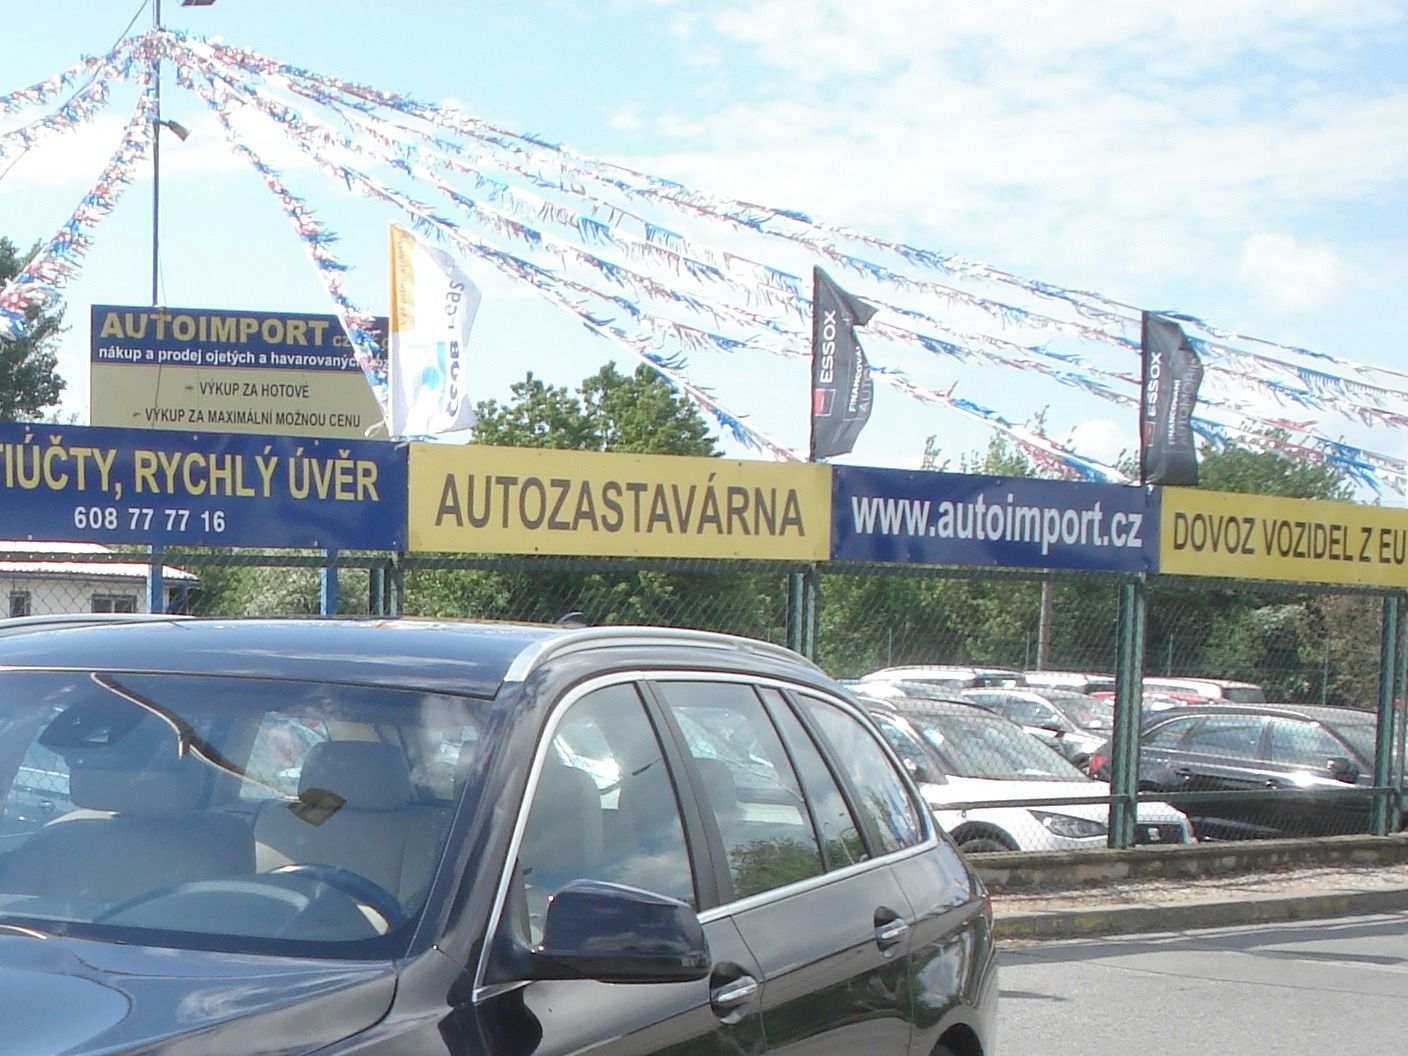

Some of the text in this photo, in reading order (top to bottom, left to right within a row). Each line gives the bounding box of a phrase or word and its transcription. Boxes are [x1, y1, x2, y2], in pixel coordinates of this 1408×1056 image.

[99, 312, 330, 346] AUTOIMPORT
[444, 280, 465, 329] Leas
[98, 345, 142, 362] nákup
[145, 350, 154, 360] a
[158, 348, 202, 363] prodej
[205, 349, 256, 366] ojetých
[259, 354, 267, 363] a
[819, 309, 837, 384] ESSOX
[199, 379, 240, 396] VÝKUP
[243, 383, 258, 397] ZA
[1146, 351, 1163, 417] ESSOX
[145, 406, 361, 428] VÝKUP ZA MAXIMÁLNÍ MOŽNOU CENU
[135, 446, 278, 496] RYCHLÝ
[288, 447, 380, 501] ÚVĚR
[74, 506, 227, 534] 608 77 77 16
[434, 471, 805, 538] AUTOZASTAVÁRNA
[851, 493, 1143, 555] www.autoimport.cz
[1173, 511, 1407, 565] DOVOZ VOZIDEL Z EU
